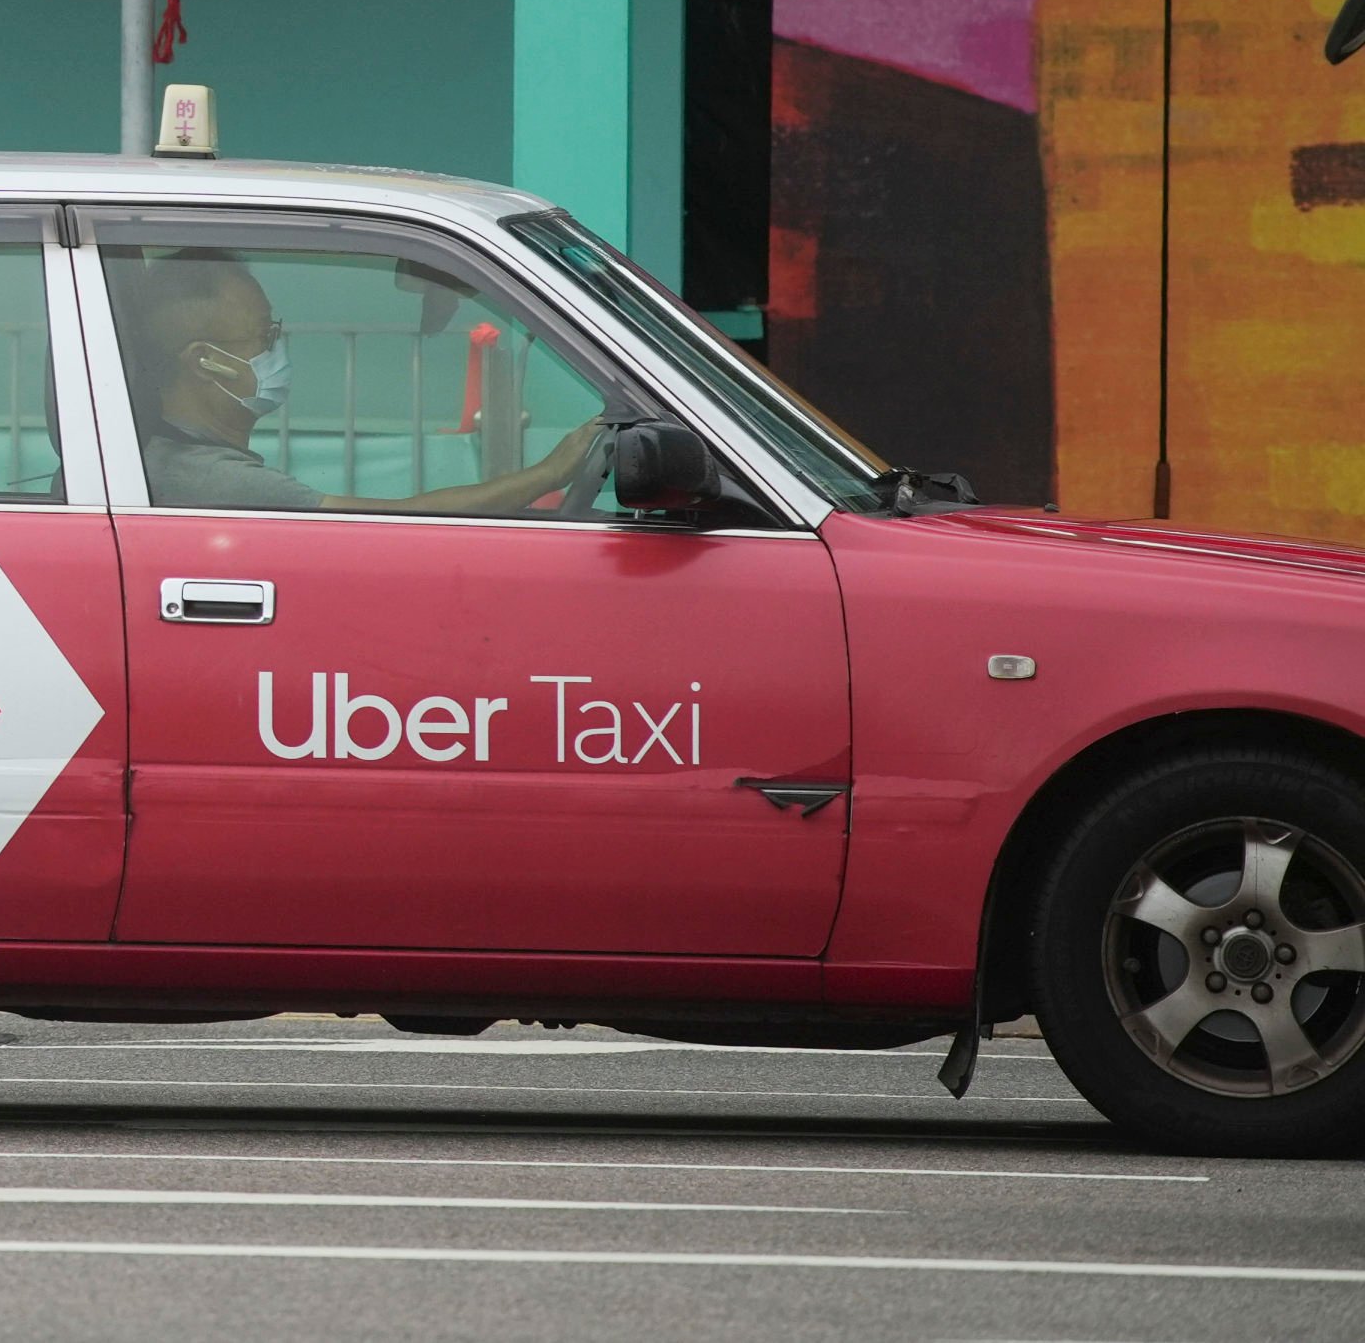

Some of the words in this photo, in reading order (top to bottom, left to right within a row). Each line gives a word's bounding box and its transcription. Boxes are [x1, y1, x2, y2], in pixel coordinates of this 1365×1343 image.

[174, 100, 196, 139] 的士
[258, 670, 508, 763] Uber
[530, 675, 703, 766] Taxi
